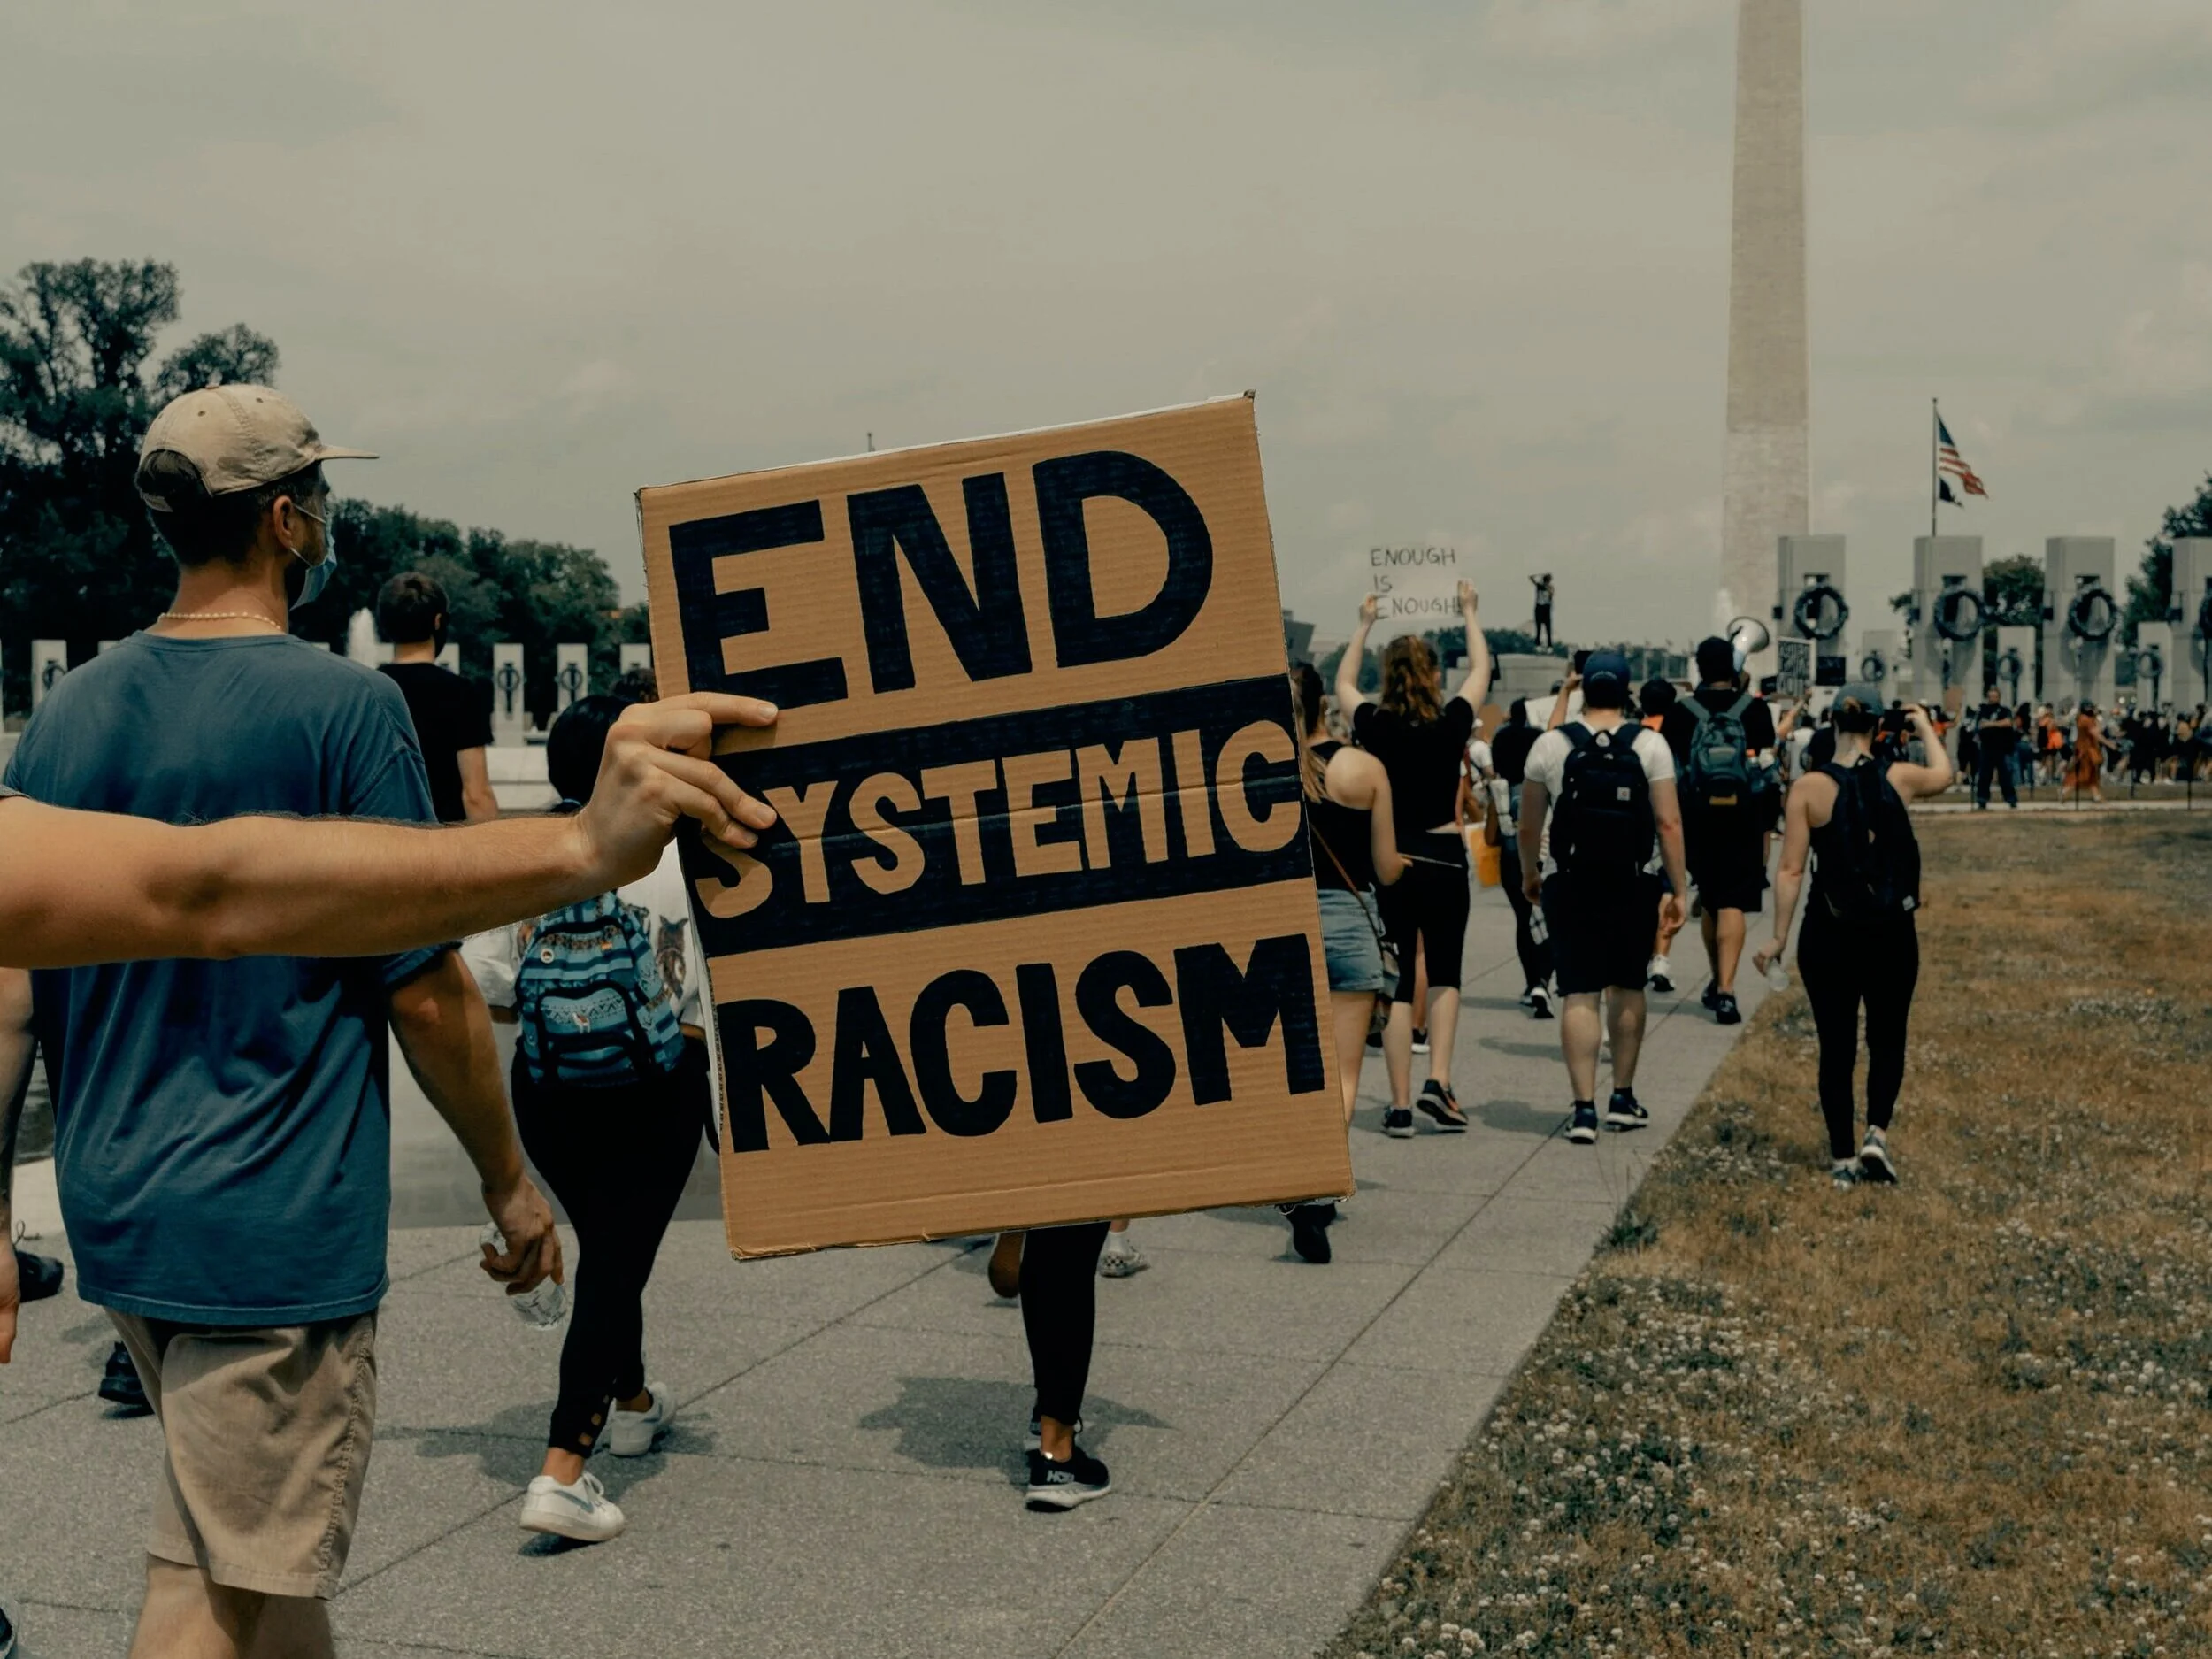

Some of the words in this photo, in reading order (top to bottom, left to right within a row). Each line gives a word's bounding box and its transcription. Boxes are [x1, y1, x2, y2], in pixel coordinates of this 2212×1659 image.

[668, 450, 1214, 710] END
[1371, 547, 1456, 566] ENOUGH
[1373, 573, 1393, 593] IS
[694, 719, 1302, 918] SYSTEMIC
[716, 933, 1325, 1154] RACISM
